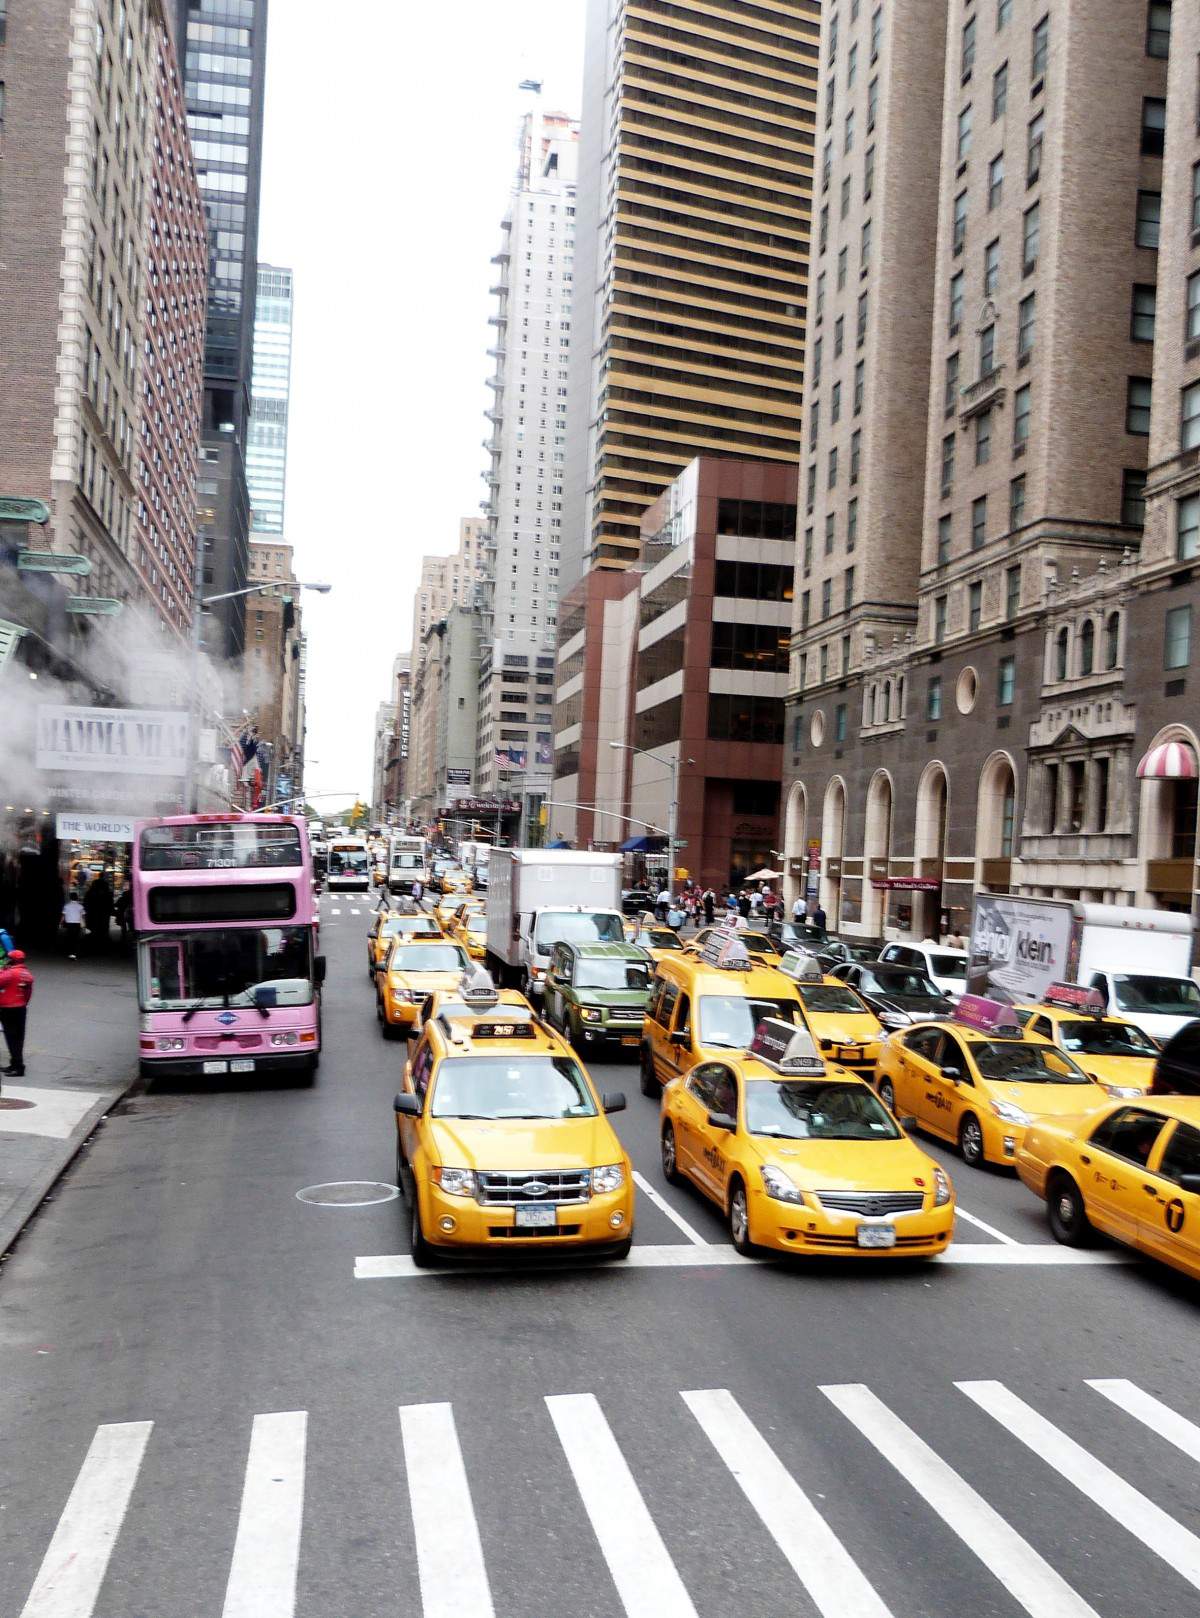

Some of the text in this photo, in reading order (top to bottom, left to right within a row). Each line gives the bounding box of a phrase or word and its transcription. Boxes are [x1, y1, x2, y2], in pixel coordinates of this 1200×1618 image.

[401, 690, 410, 757] WELLINGTON
[61, 821, 130, 834] THE WORLD'S
